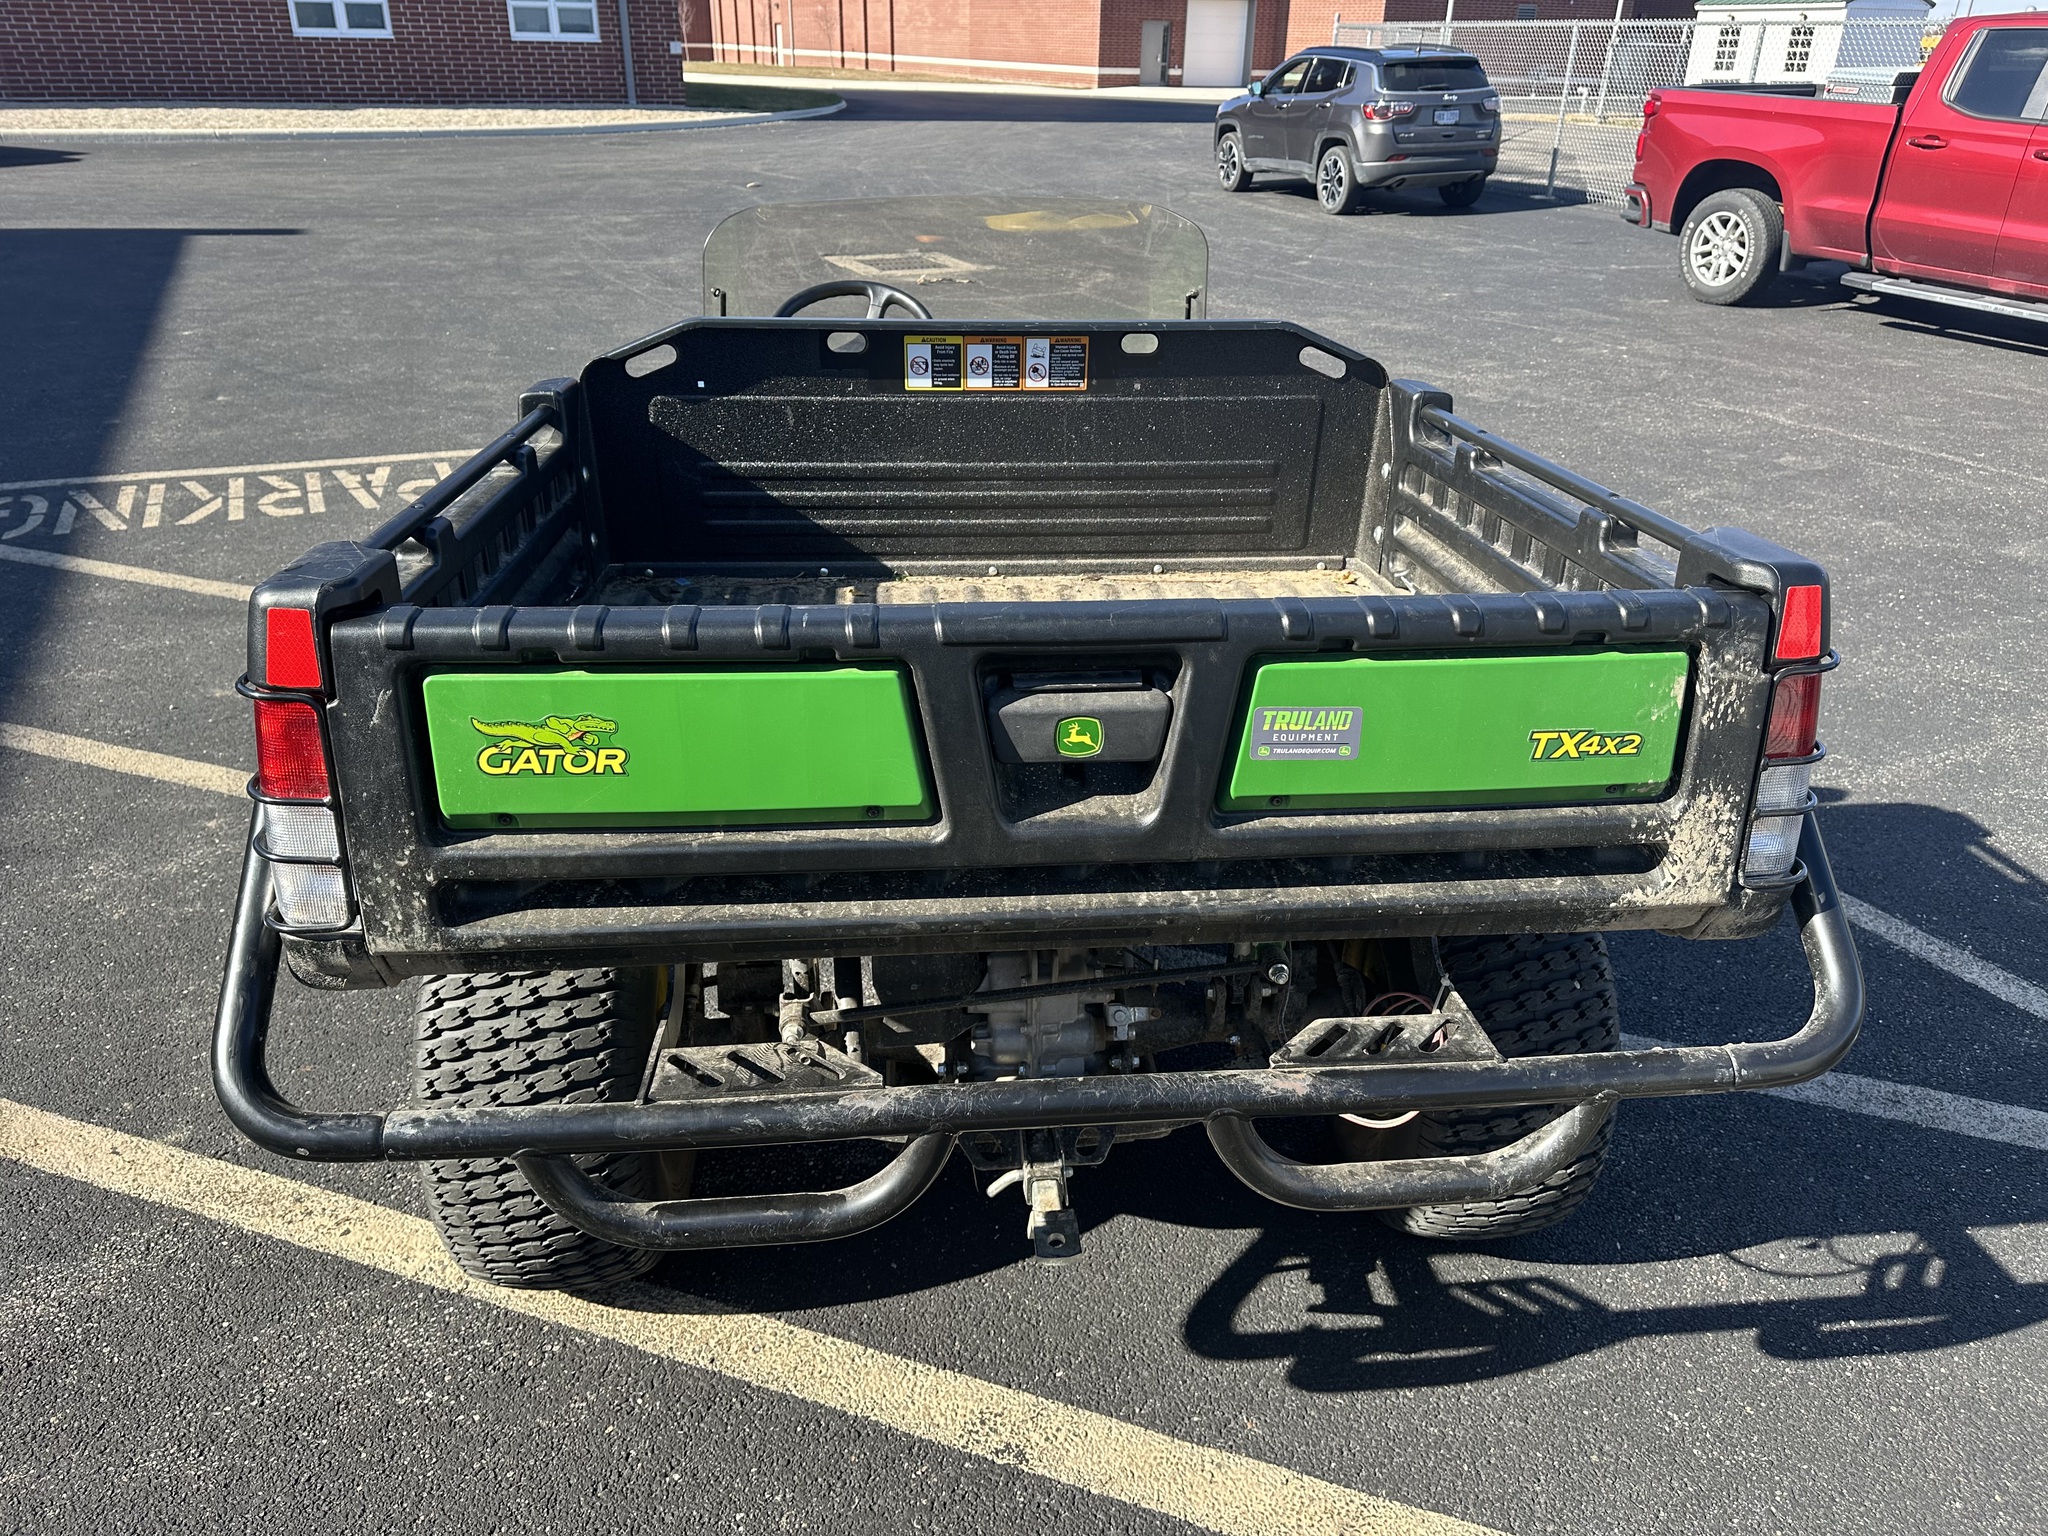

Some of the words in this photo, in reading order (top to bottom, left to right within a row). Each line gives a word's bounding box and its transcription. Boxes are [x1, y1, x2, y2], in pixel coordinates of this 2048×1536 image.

[1262, 710, 1354, 731] TRULAND
[1272, 733, 1339, 742] EQUIPMENT
[477, 746, 627, 776] GATOR
